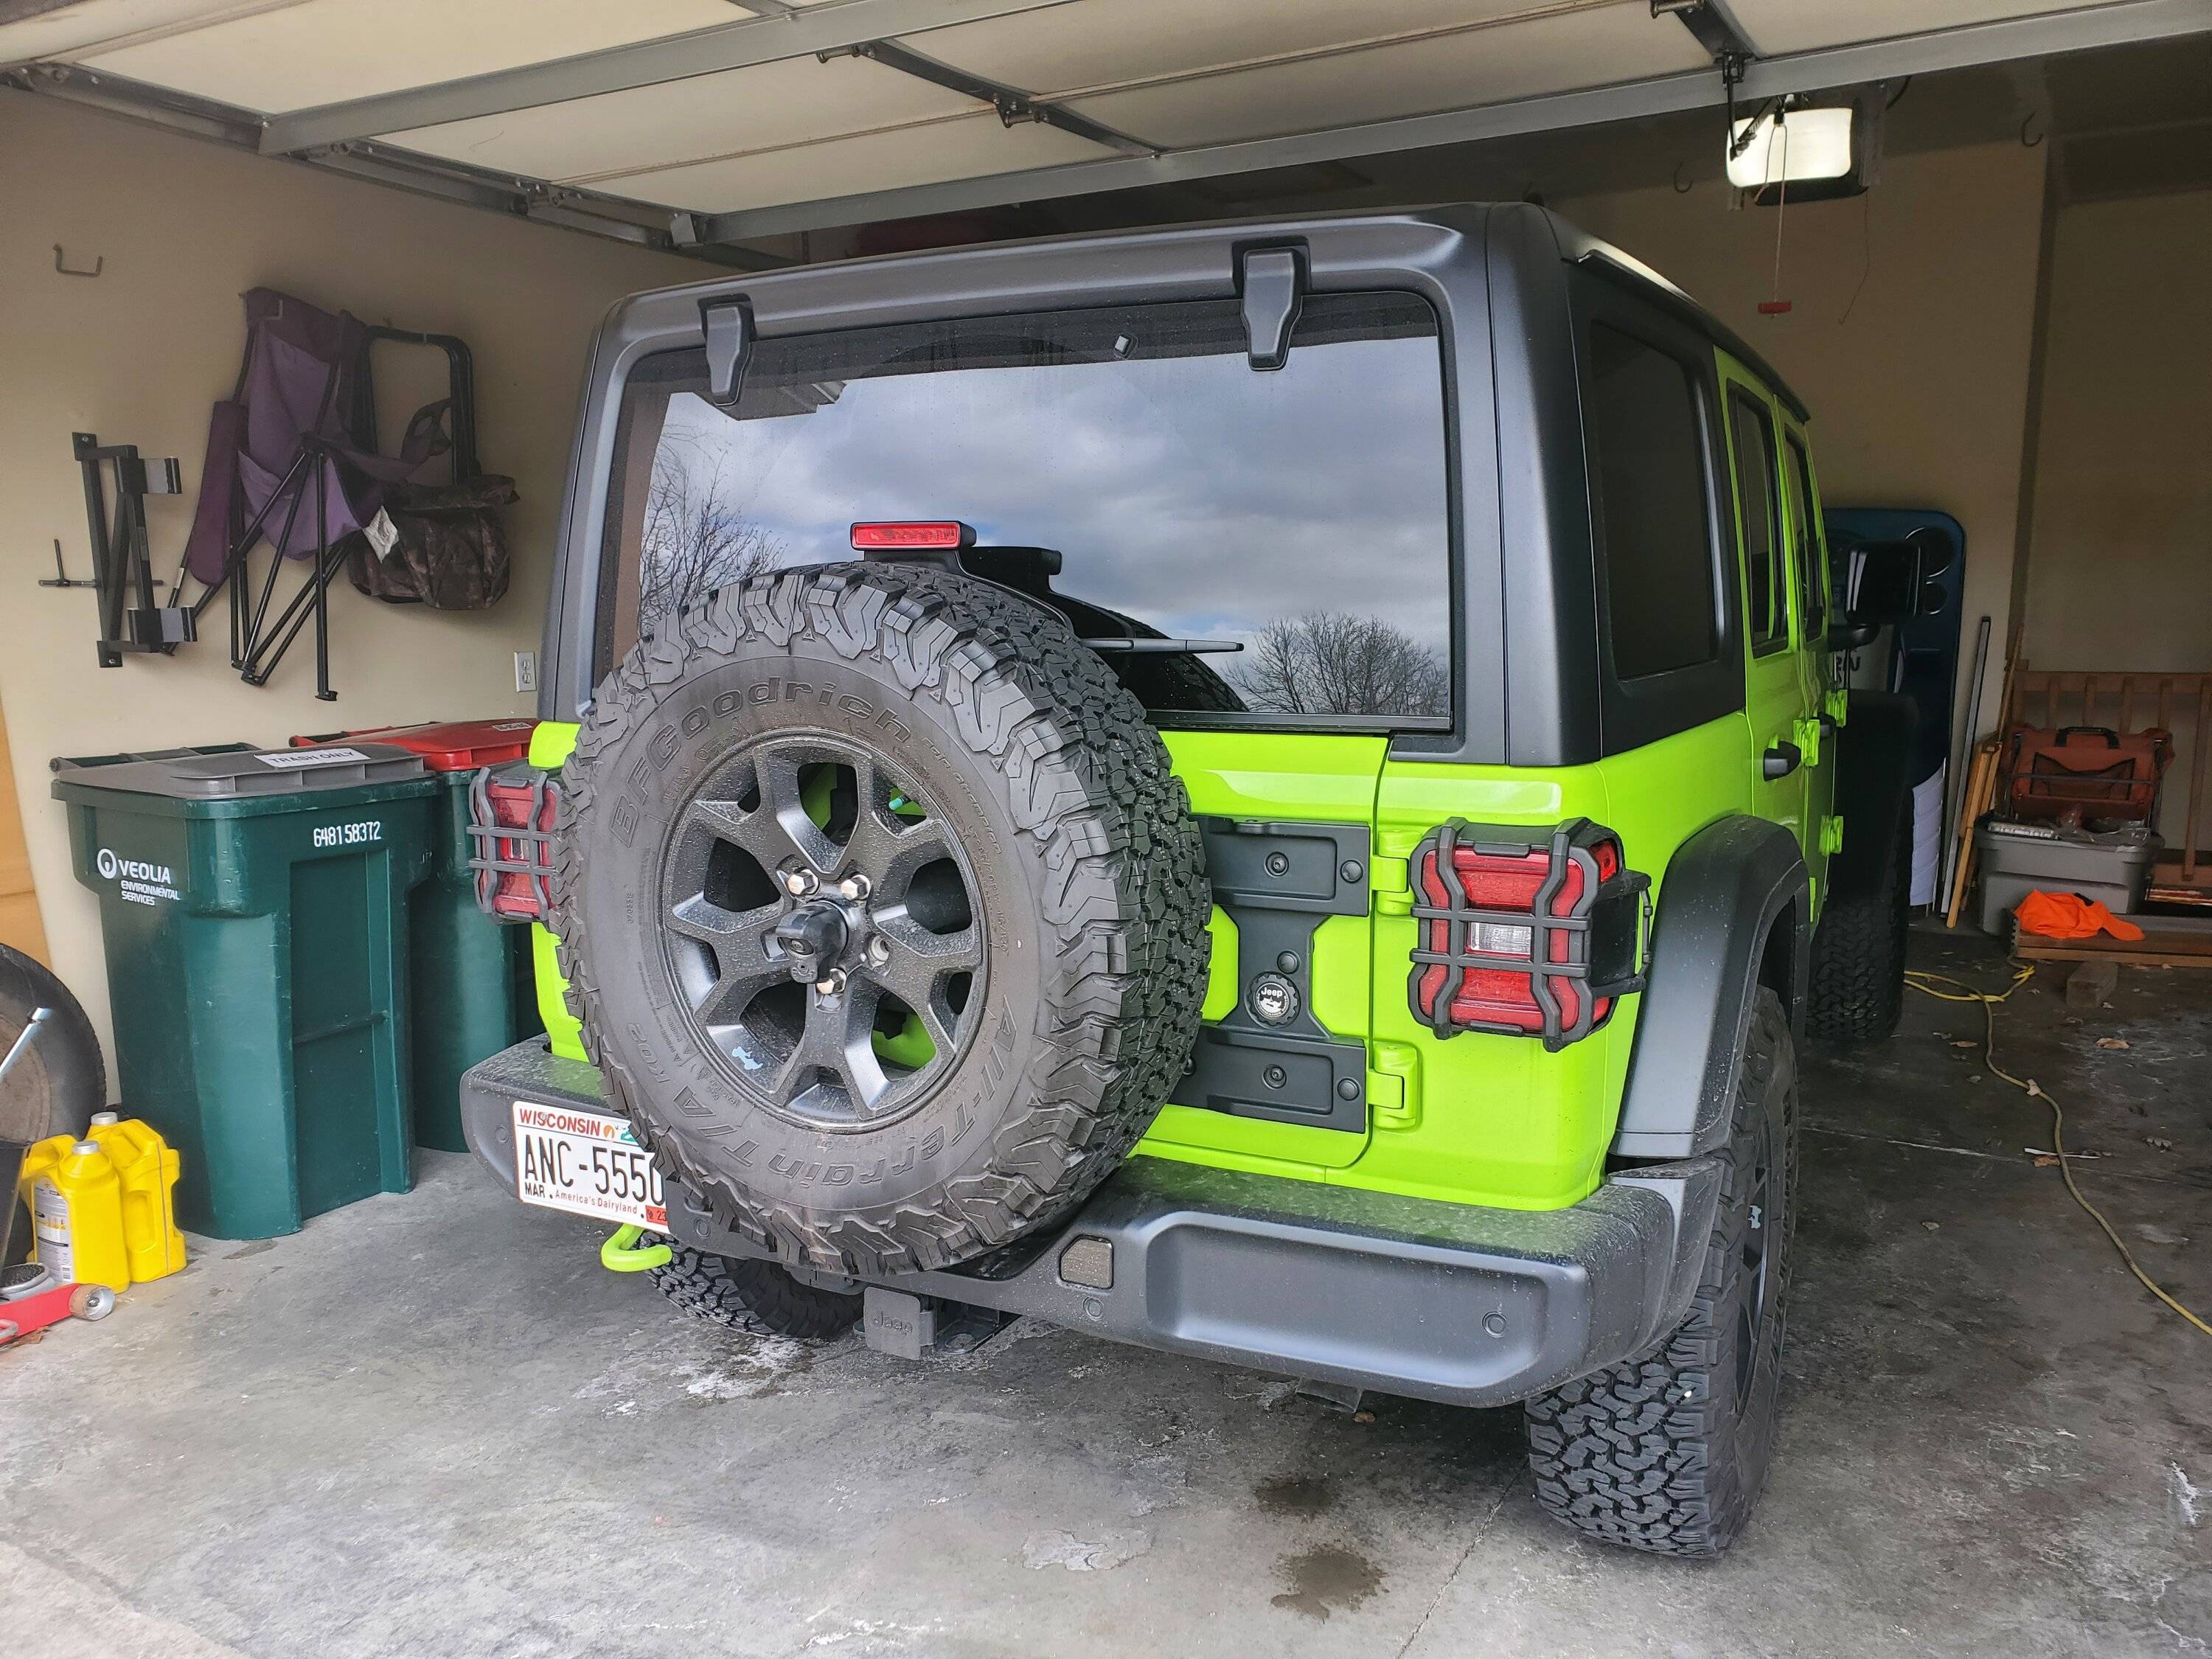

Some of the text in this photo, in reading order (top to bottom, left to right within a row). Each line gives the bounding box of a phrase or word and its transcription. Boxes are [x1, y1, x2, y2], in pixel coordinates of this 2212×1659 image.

[268, 751, 355, 763] TRASH ONLY
[611, 676, 911, 848] BFGoodrich
[118, 859, 171, 885] VEOLIA
[121, 880, 181, 901] ENVIRONMENTAL
[121, 890, 156, 906] SERVICES
[1261, 987, 1283, 998] Jeep
[519, 1108, 601, 1136] WISCONSIN
[672, 1085, 760, 1167] T/A
[524, 1134, 665, 1206] ANC-5550
[524, 1182, 546, 1198] MAR
[554, 1190, 596, 1206] America's
[597, 1197, 638, 1214] Dairyland
